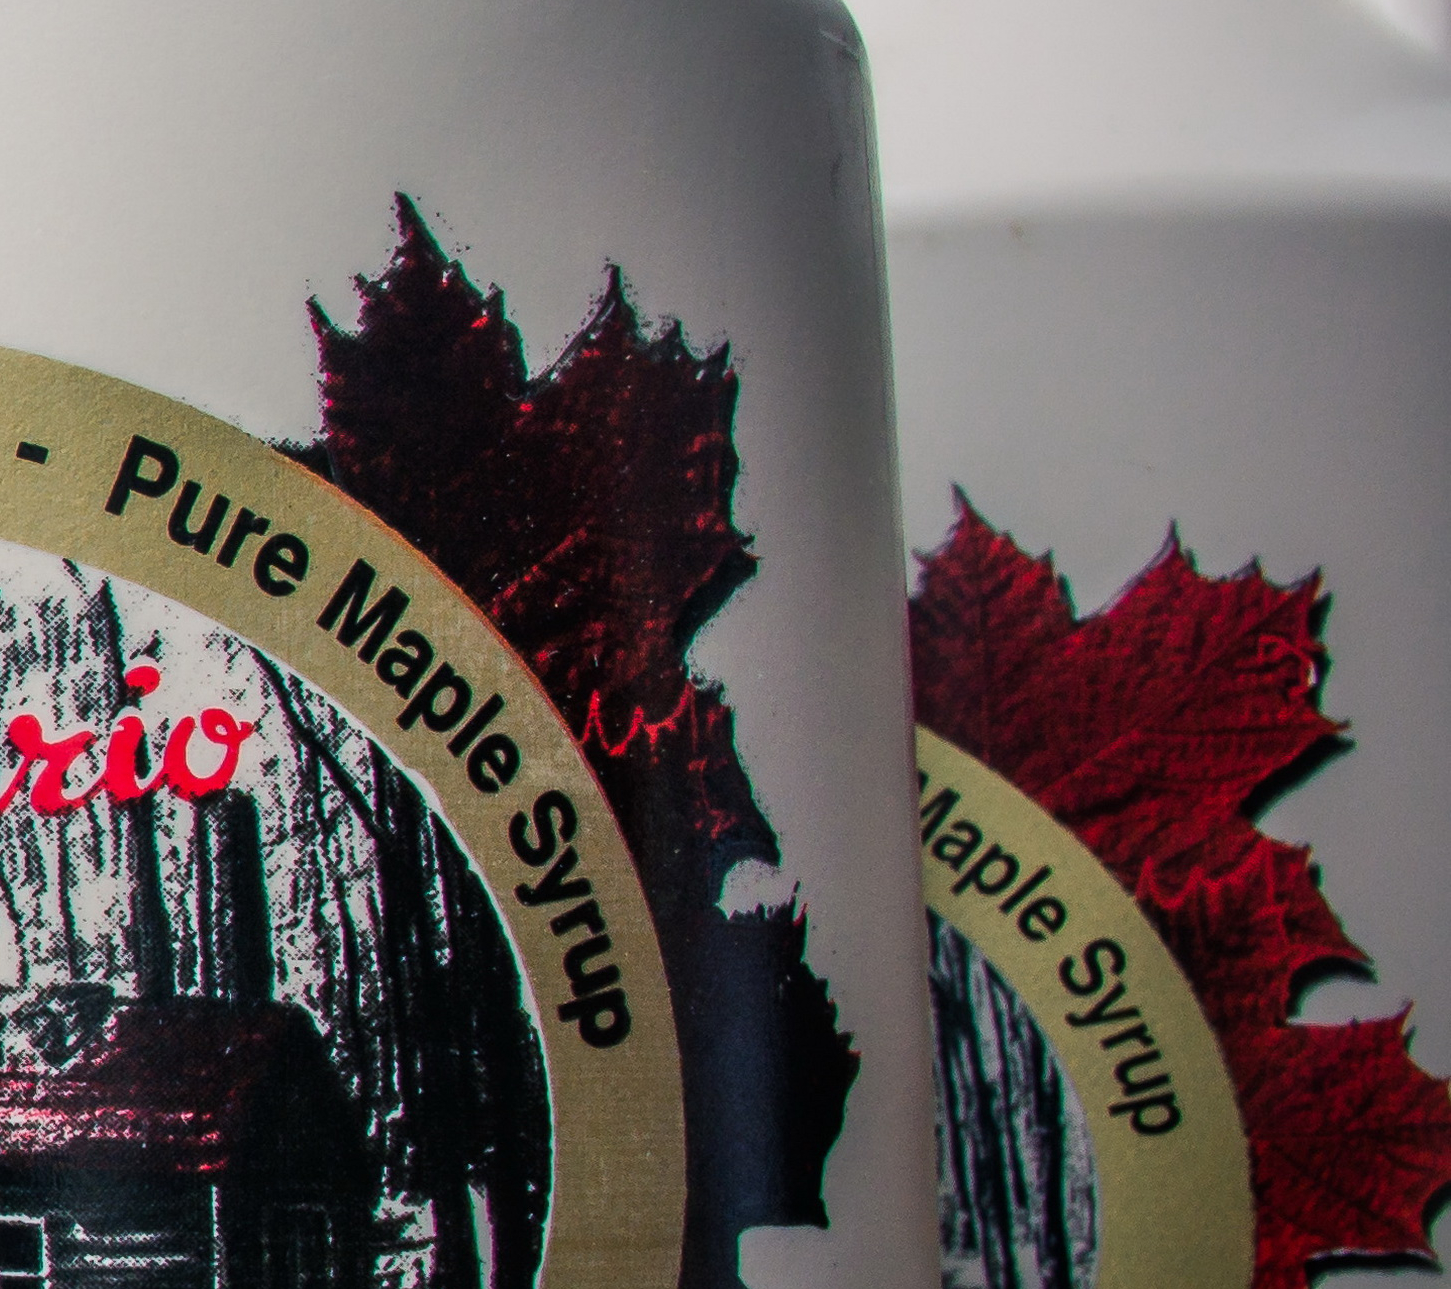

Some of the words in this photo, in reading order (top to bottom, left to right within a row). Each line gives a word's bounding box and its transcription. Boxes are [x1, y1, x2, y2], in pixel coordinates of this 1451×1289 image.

[104, 434, 311, 598] Pure
[316, 557, 524, 796] Maple
[507, 787, 634, 1050] Syrup
[1057, 937, 1184, 1137] Syrup
